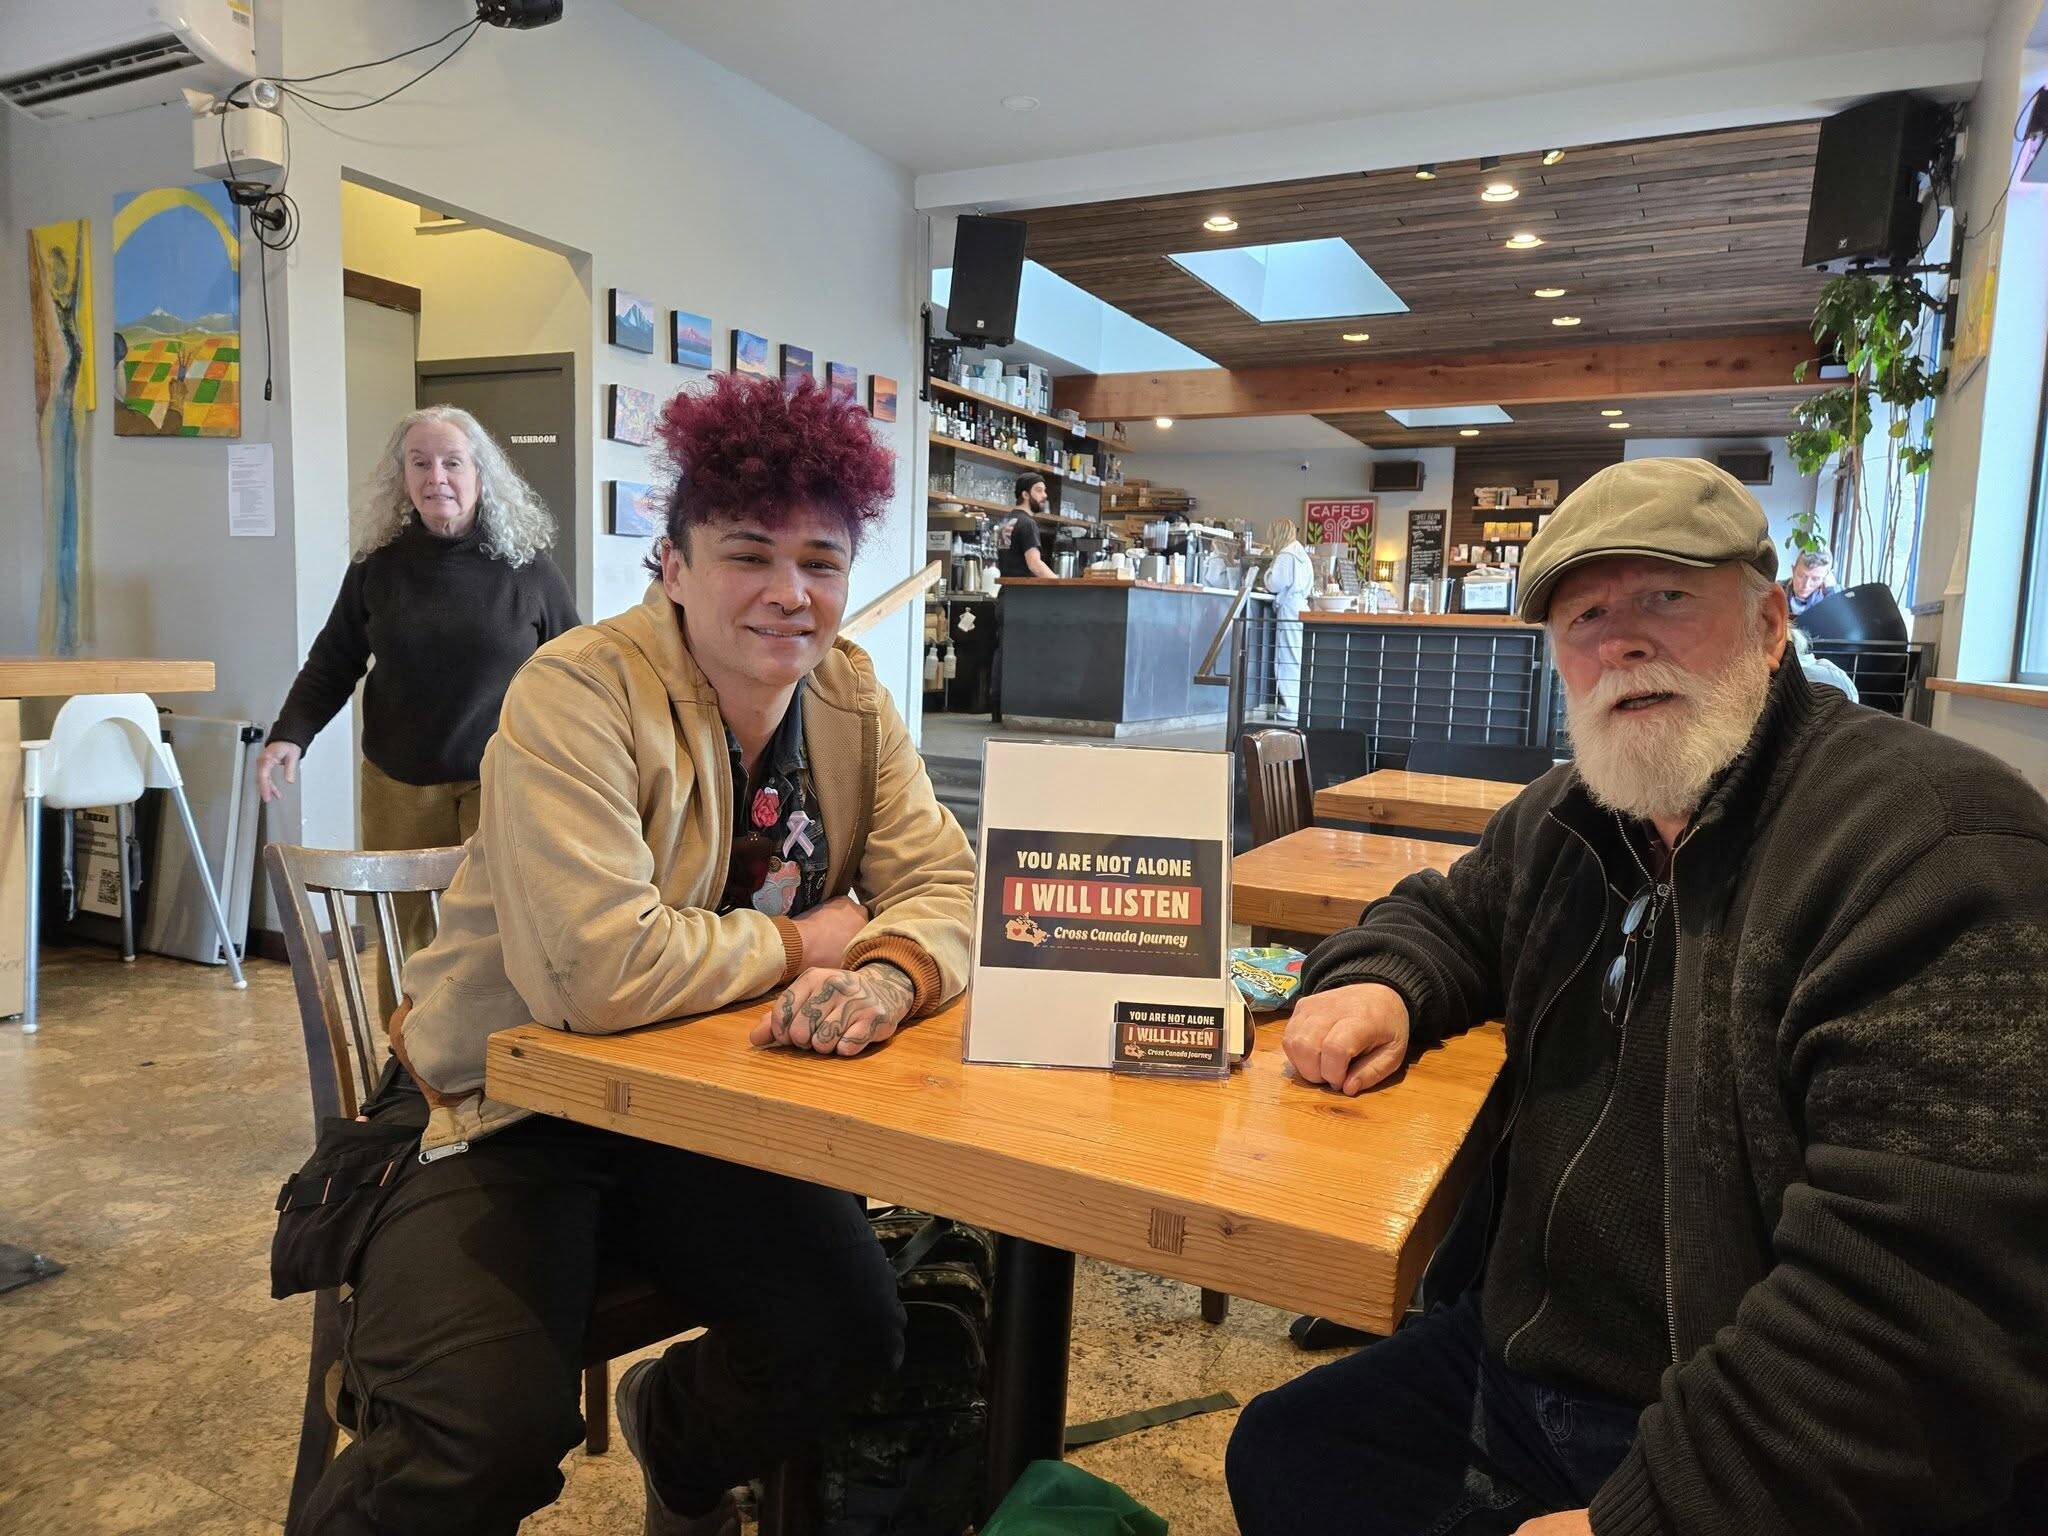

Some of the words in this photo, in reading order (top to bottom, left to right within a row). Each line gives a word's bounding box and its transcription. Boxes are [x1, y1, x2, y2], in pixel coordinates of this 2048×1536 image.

[510, 435, 557, 444] WASHROOM
[1017, 850, 1053, 870] YOU
[1056, 853, 1092, 872] ARE
[1095, 854, 1132, 874] NOT
[1135, 857, 1192, 878] ALONE
[1014, 882, 1024, 911] I
[1031, 883, 1092, 915] WILL
[1100, 887, 1190, 920] LISTEN
[1054, 926, 1088, 941] Cross
[1090, 928, 1137, 944] Canada
[1138, 931, 1188, 949] Journey
[1129, 1010, 1148, 1021] YOU
[1148, 1012, 1167, 1023] ARE
[1167, 1013, 1186, 1024] NOT
[1187, 1014, 1215, 1026] ALONE
[1128, 1026, 1134, 1042] I
[1137, 1026, 1168, 1043] WILL
[1169, 1029, 1214, 1047] LISTEN
[1147, 1048, 1165, 1057] Cross
[1165, 1049, 1188, 1059] Canada
[1188, 1051, 1213, 1061] Journey
